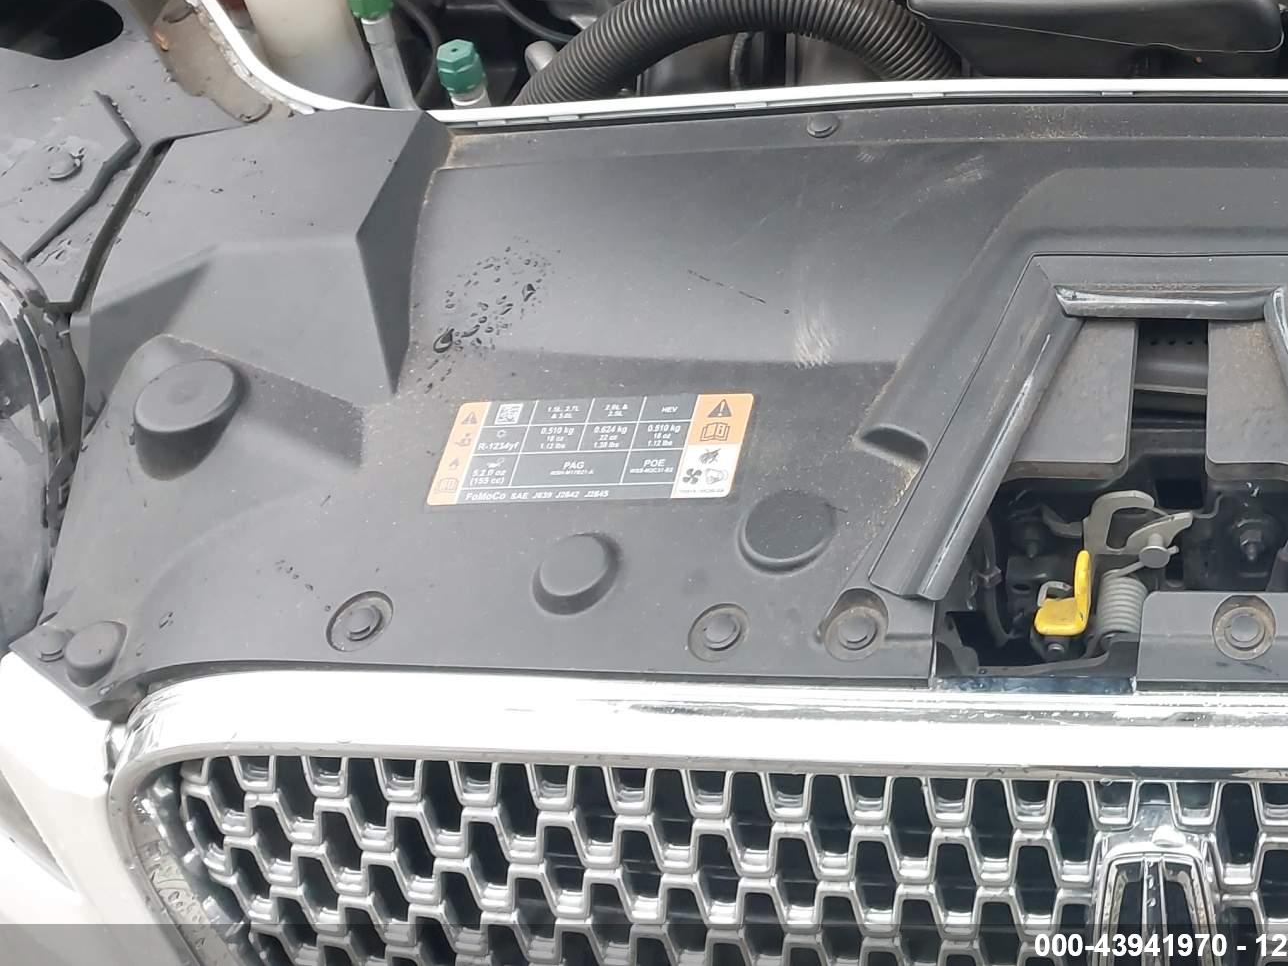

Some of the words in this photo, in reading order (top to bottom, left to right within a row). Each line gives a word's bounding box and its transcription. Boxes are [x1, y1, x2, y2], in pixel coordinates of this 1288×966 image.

[540, 427, 562, 435] 0.510
[563, 426, 575, 436] kg
[593, 425, 616, 434] 0.624
[617, 425, 628, 436] kg
[647, 424, 669, 433] 0.510
[670, 424, 681, 434] kg
[477, 441, 520, 452] R-1234yf
[563, 461, 585, 470] PAG
[643, 459, 667, 467] POE
[470, 477, 490, 485] (155
[465, 491, 506, 501] FoMoCo
[510, 492, 529, 500] SAE
